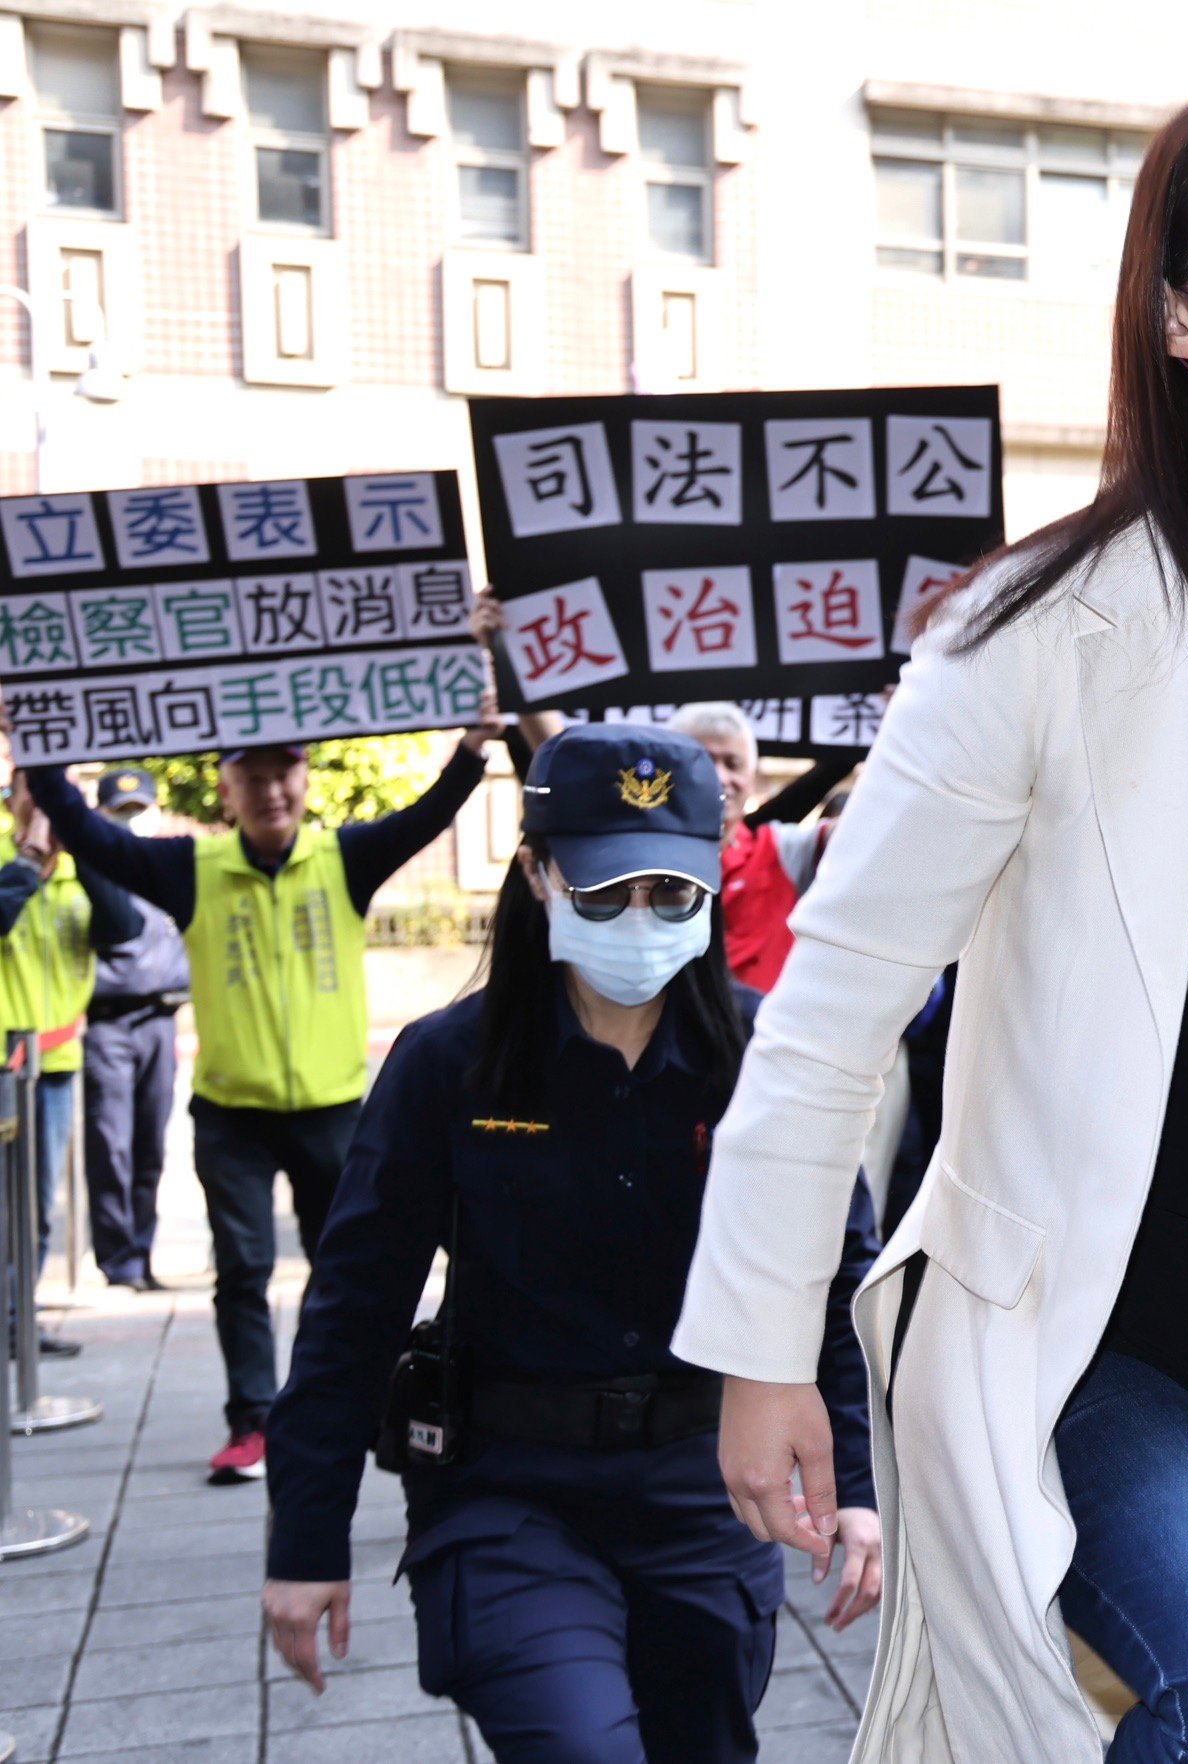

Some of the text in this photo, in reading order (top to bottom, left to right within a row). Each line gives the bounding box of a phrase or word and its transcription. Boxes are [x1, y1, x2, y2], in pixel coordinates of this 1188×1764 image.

[524, 424, 985, 518] 司法不公
[15, 480, 431, 565] 立委表示
[0, 566, 469, 669] 檢察官放消息
[517, 569, 968, 683] 政治迫
[5, 653, 487, 755] 帶風向手段低俗
